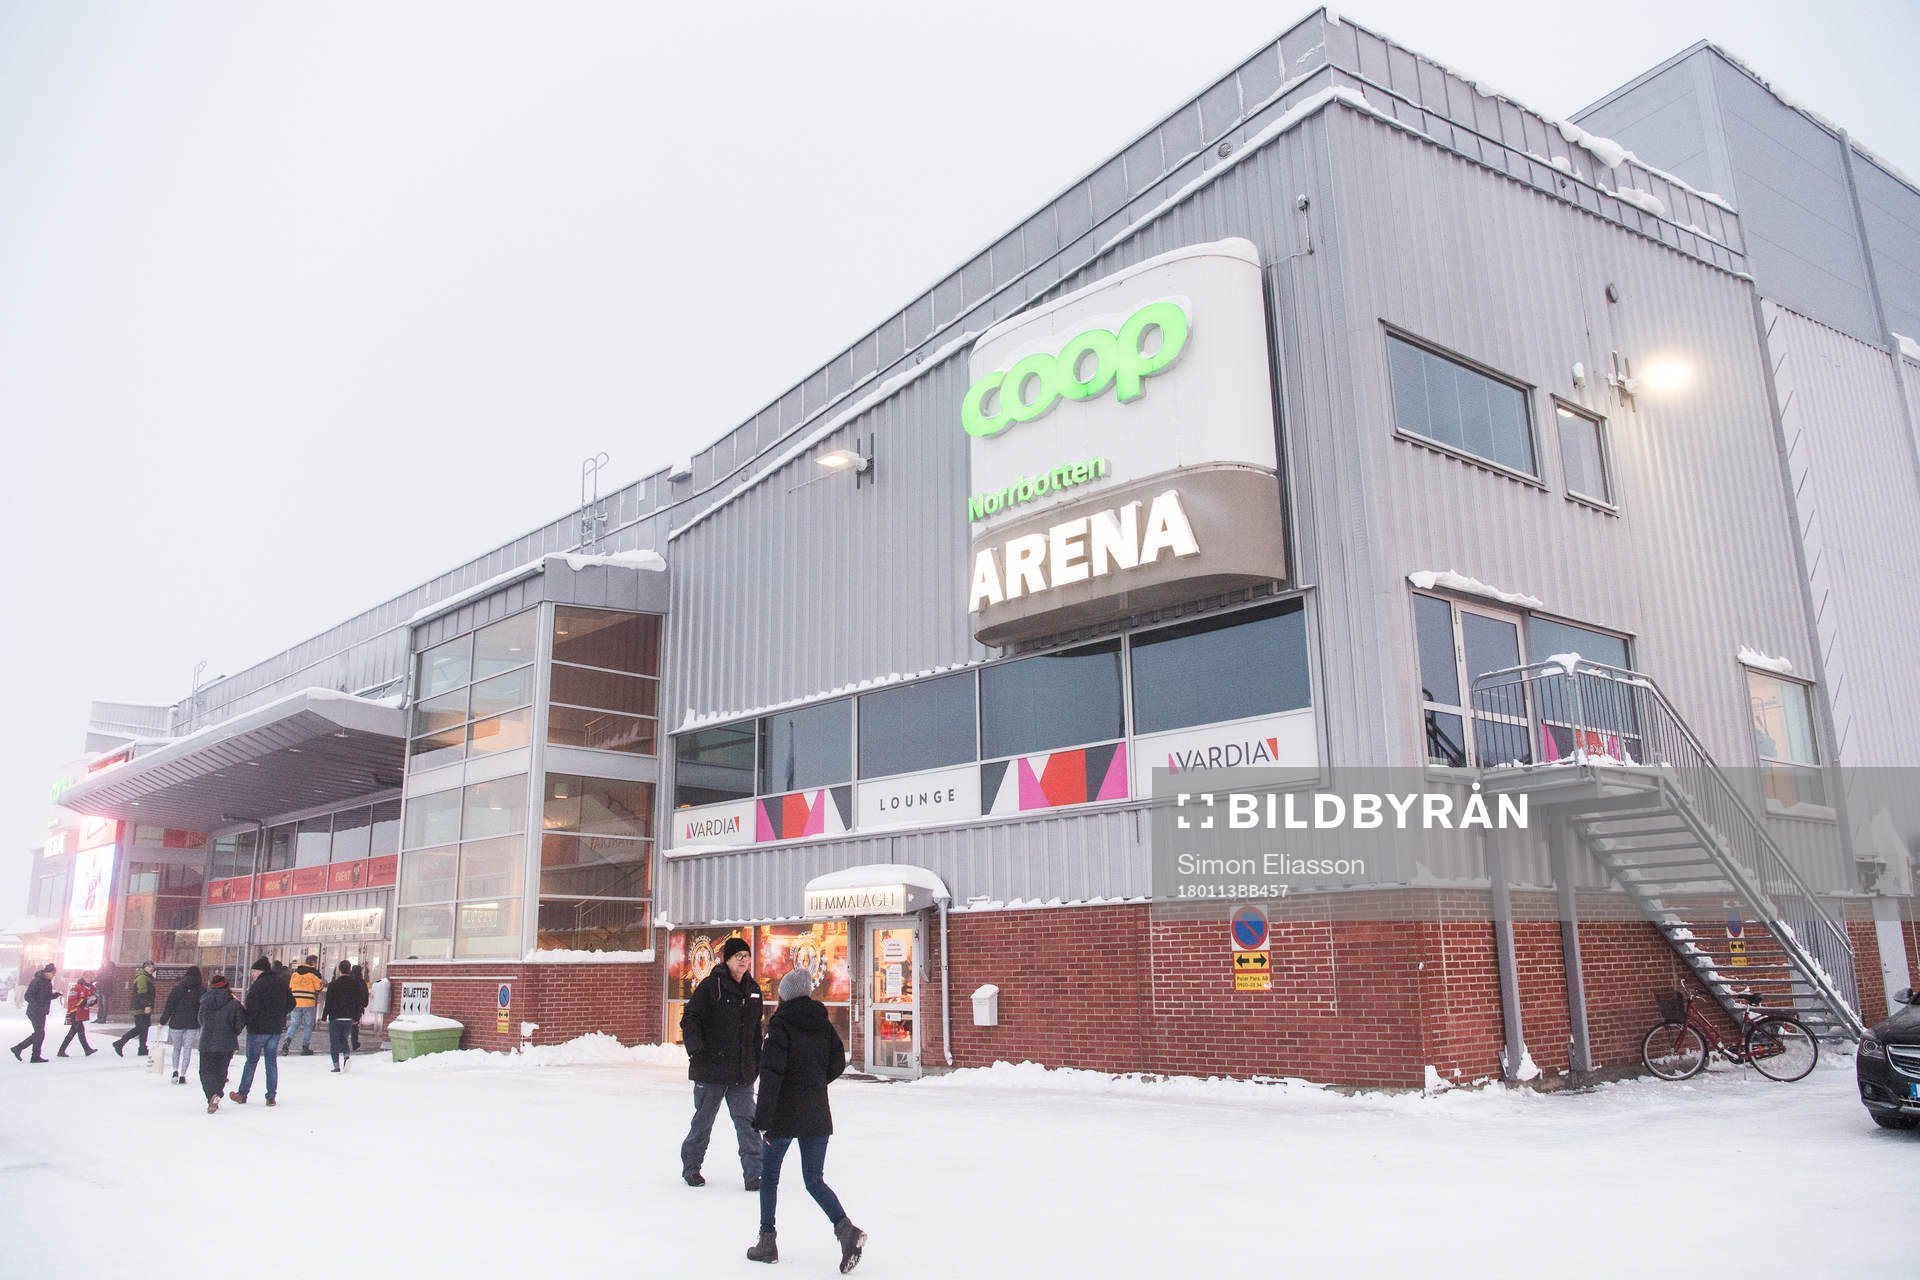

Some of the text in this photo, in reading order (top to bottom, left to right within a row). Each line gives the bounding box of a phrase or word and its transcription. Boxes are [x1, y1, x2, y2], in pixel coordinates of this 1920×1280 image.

[961, 301, 1191, 438] coop
[968, 455, 1108, 522] Norrbotten
[968, 490, 1200, 614] ARENA
[1176, 740, 1270, 772] VARDIA
[879, 788, 956, 811] LOUNGE
[691, 817, 736, 838] VARDIA
[402, 987, 429, 998] BILJETTER
